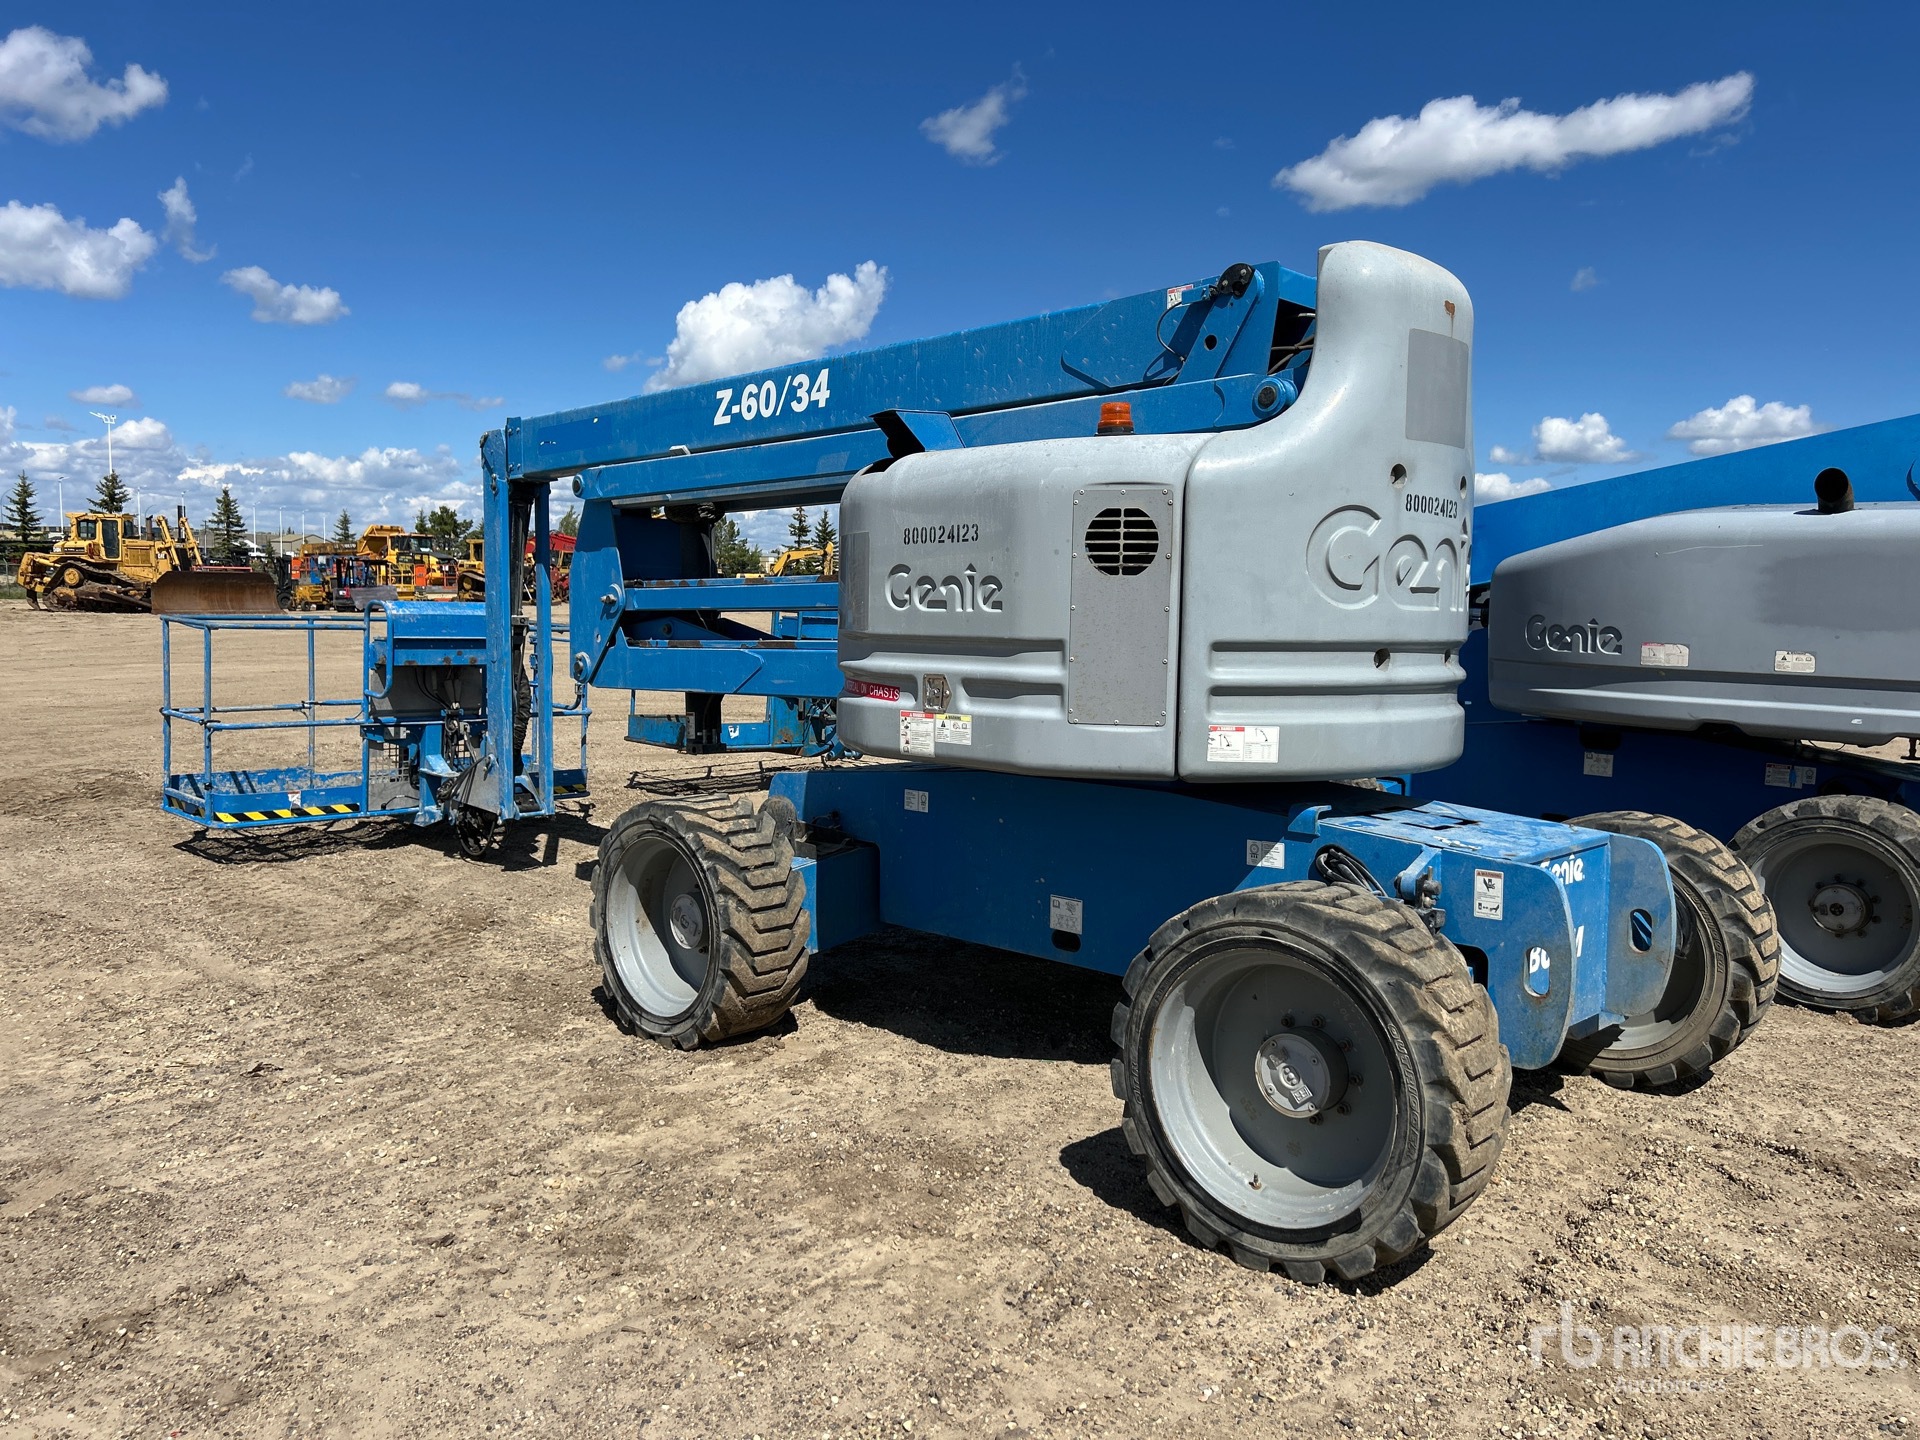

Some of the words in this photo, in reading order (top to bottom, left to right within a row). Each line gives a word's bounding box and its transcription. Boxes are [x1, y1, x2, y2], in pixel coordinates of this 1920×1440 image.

[713, 368, 831, 426] Z-60/34
[1405, 493, 1459, 519] 800024123
[903, 523, 979, 545] 800024123
[1306, 504, 1471, 612] Geni
[885, 563, 1003, 612] Genie
[1525, 614, 1622, 655] Genie
[869, 684, 900, 700] CHASIS
[1387, 1023, 1420, 1161] OUTRIGGER
